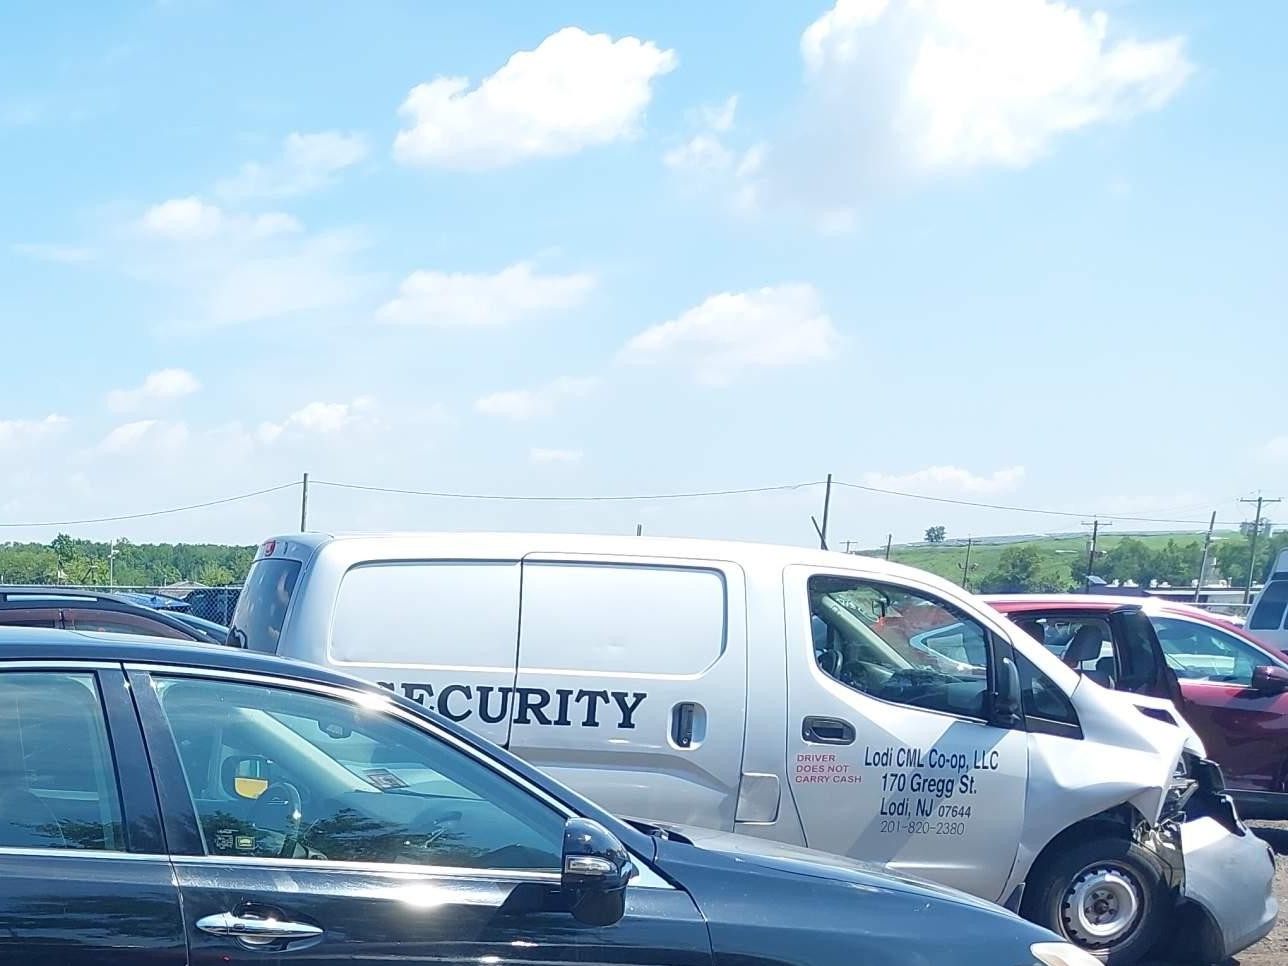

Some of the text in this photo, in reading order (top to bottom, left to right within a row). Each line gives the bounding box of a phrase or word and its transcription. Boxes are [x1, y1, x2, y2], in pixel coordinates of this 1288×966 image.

[797, 754, 836, 762] DRIVER
[864, 746, 999, 774] Lodi CML Co-op, LLC
[796, 764, 849, 773] DOES NOT
[795, 775, 862, 783] CARRY CASH
[882, 773, 977, 798] 170 Gregg St.
[880, 797, 971, 818] Lodi, NJ 07644
[880, 820, 965, 835] 201-820-2380
